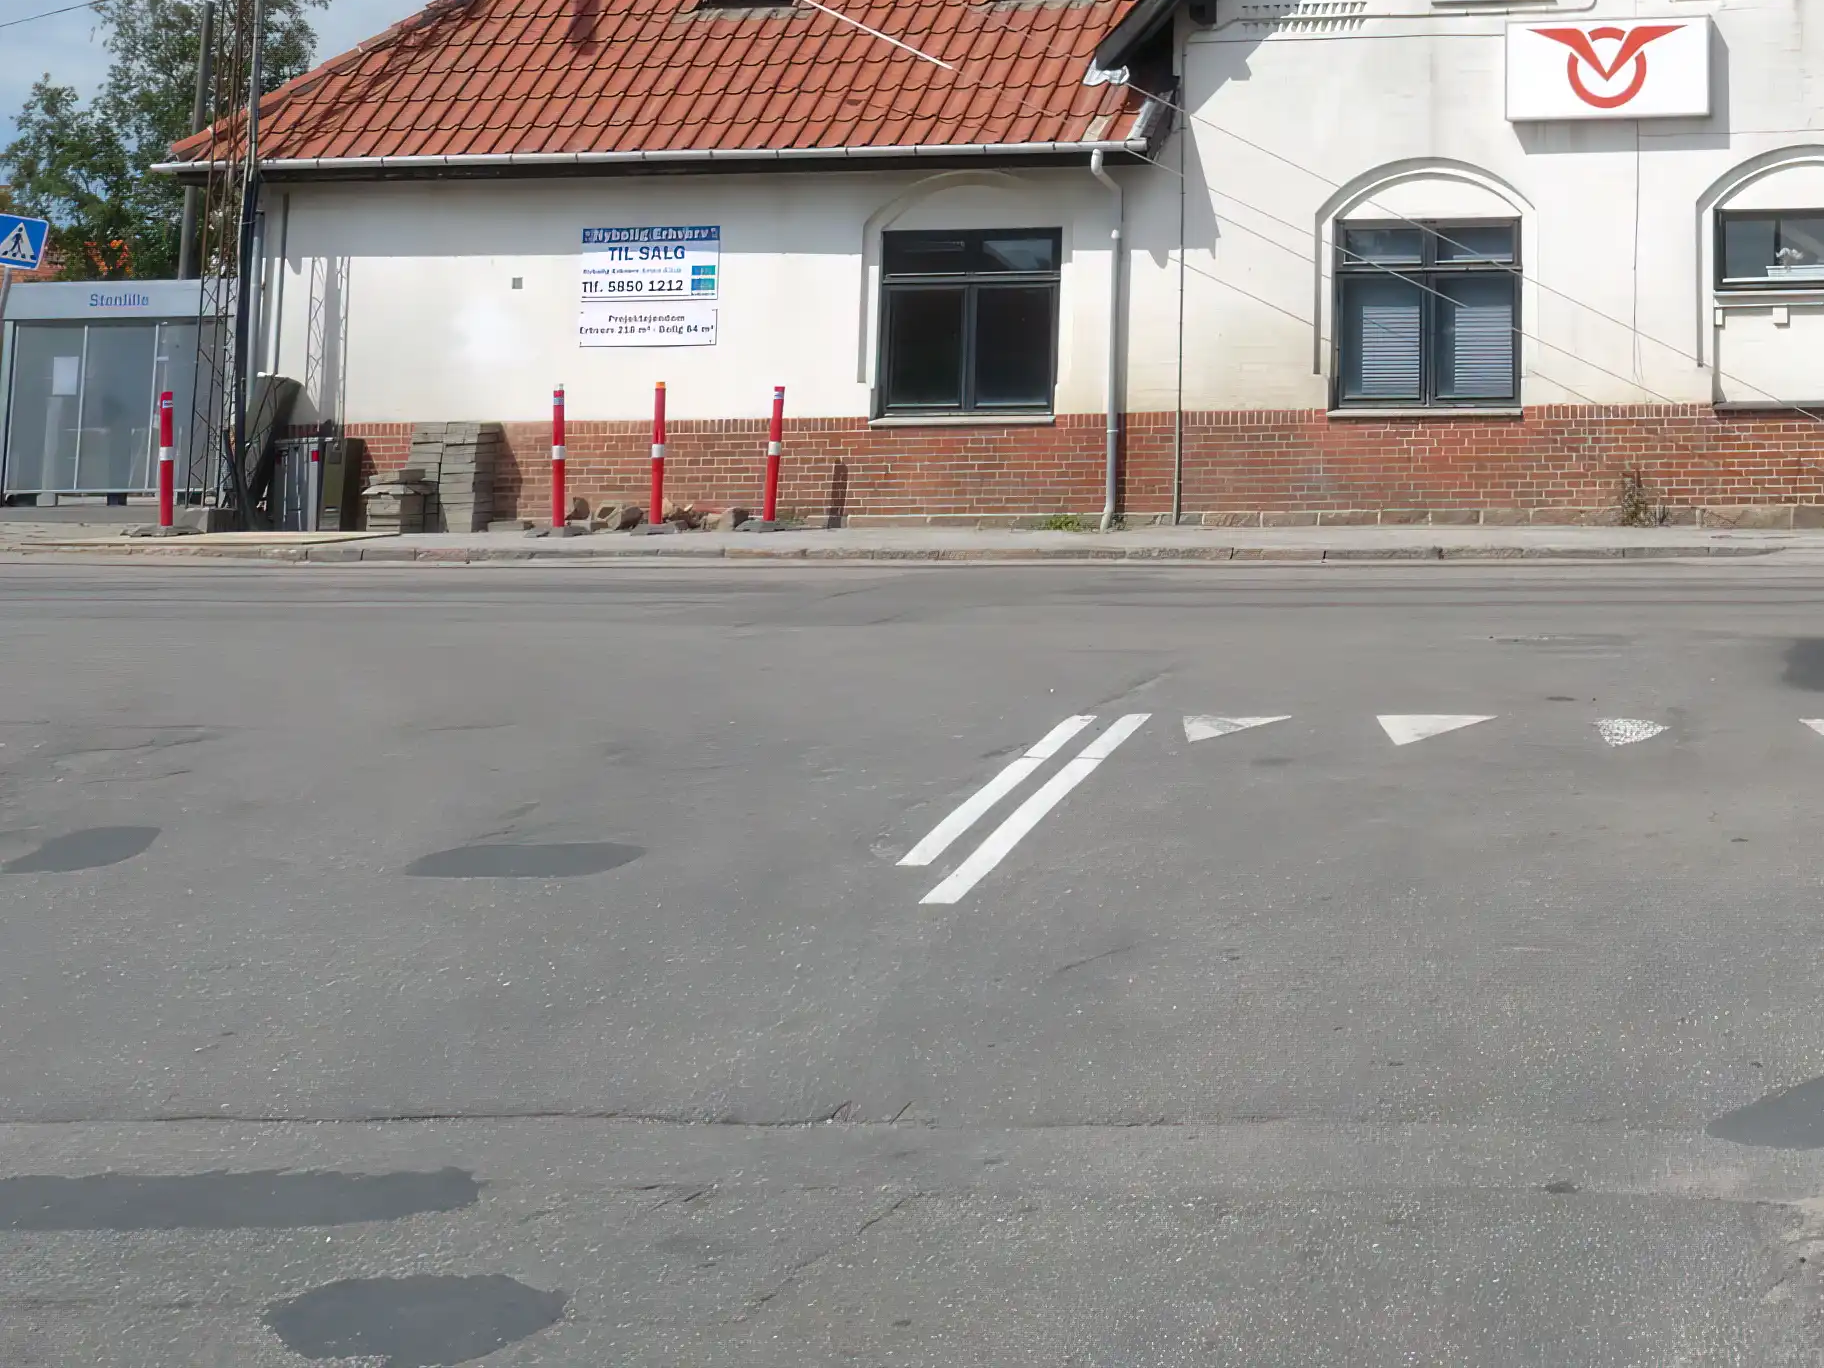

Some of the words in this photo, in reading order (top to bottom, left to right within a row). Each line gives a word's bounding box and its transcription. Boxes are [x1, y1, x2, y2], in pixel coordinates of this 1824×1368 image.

[608, 246, 633, 261] TIL
[639, 245, 686, 260] SALG
[581, 280, 603, 293] Tlf.
[608, 280, 643, 293] 5850
[648, 279, 683, 292] 1212
